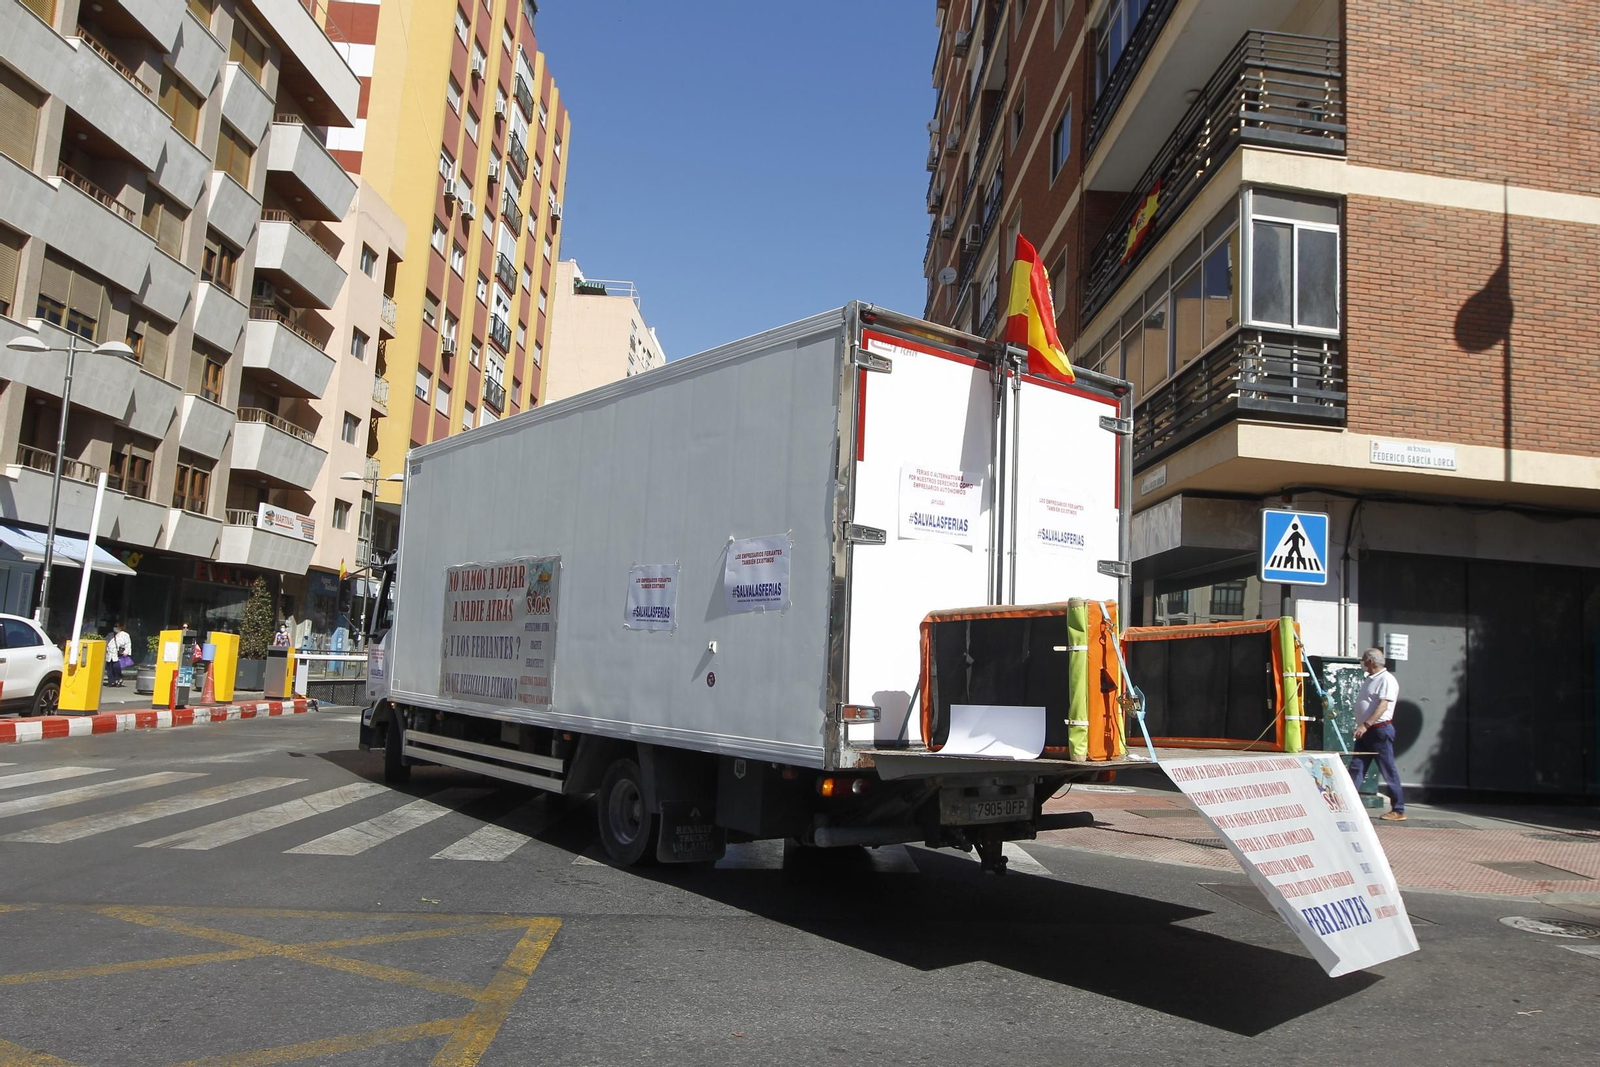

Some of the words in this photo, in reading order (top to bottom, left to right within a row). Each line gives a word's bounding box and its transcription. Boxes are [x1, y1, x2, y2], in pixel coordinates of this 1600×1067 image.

[1406, 445, 1431, 453] AVENIDA
[1373, 451, 1405, 462] FEDERICO
[1407, 455, 1431, 465] GARCÍA
[1433, 457, 1454, 467] LORCA
[916, 468, 929, 477] FERIAS
[934, 471, 964, 481] ALTERNATIVAS
[917, 475, 936, 484] NUESTROS
[937, 478, 958, 488] DERECHOS
[913, 481, 939, 491] EMPRESARIOS
[909, 511, 969, 532] #SALVALASFERIAS
[1037, 528, 1084, 547] #SALVALASFERIAS
[448, 571, 459, 592] NO
[461, 569, 487, 591] VAMOS
[488, 568, 494, 589] A
[496, 565, 525, 592] DEJAR
[732, 582, 782, 598] #SALVALASFERIAS
[452, 601, 458, 622] A
[460, 600, 485, 622] NADIE
[486, 594, 513, 622] ATRÁS
[632, 605, 670, 618] #SALVALASFERIAS
[450, 635, 455, 656] Y
[456, 635, 470, 657] LOS
[471, 635, 514, 659] FERIANTES
[977, 802, 1003, 817] 7905
[1005, 800, 1025, 815] DFP
[675, 825, 712, 835] RENAULT
[1301, 895, 1372, 936] FERIANTES
